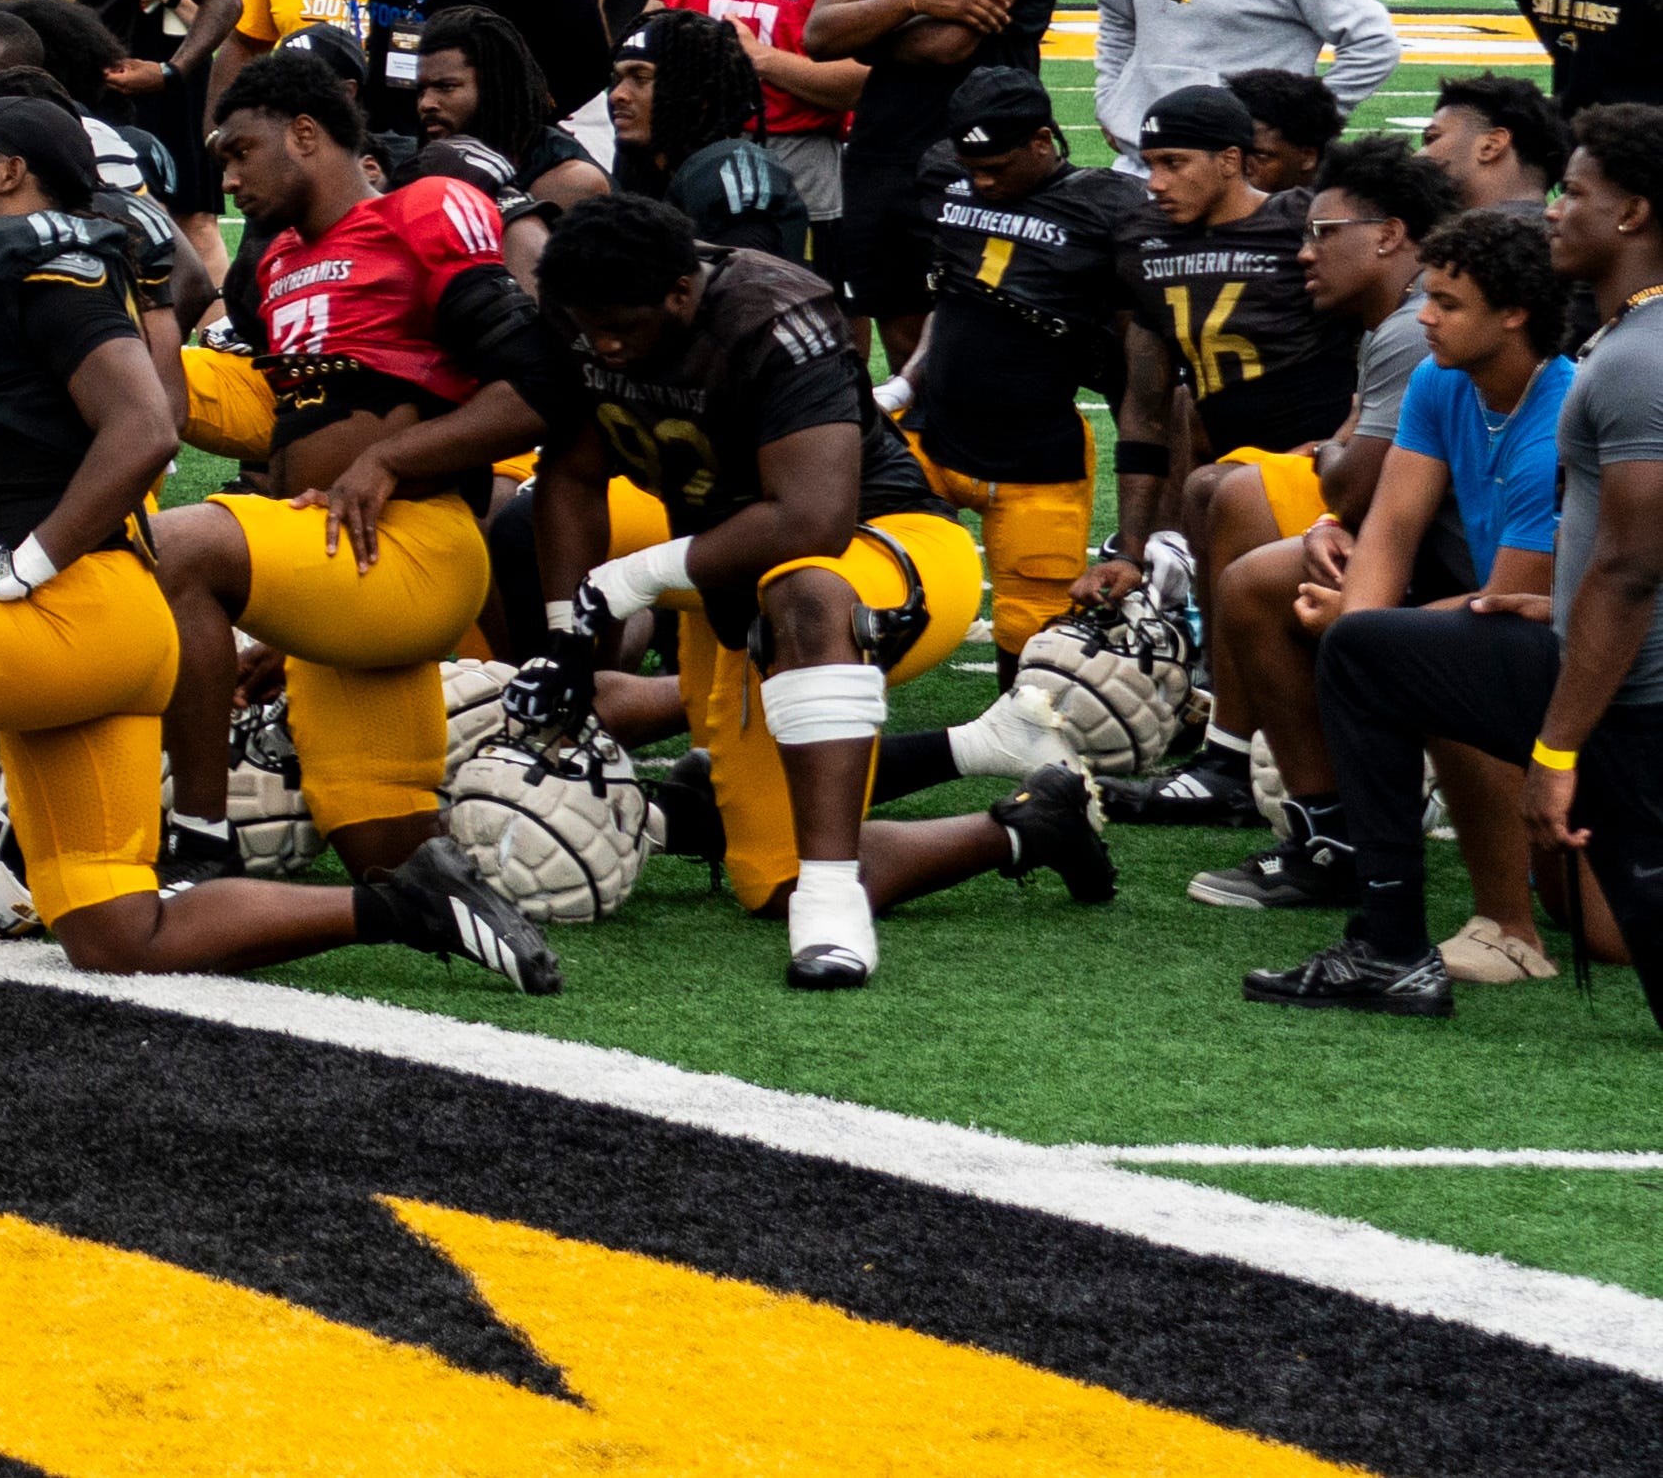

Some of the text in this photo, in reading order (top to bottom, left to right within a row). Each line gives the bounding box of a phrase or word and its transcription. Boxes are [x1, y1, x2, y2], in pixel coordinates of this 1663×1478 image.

[936, 202, 1069, 246] SOUTHERN MISS
[318, 259, 353, 281] MISS
[974, 236, 1016, 289] 1
[1142, 251, 1280, 281] SOUTHERN MISS
[1163, 281, 1265, 401] 16
